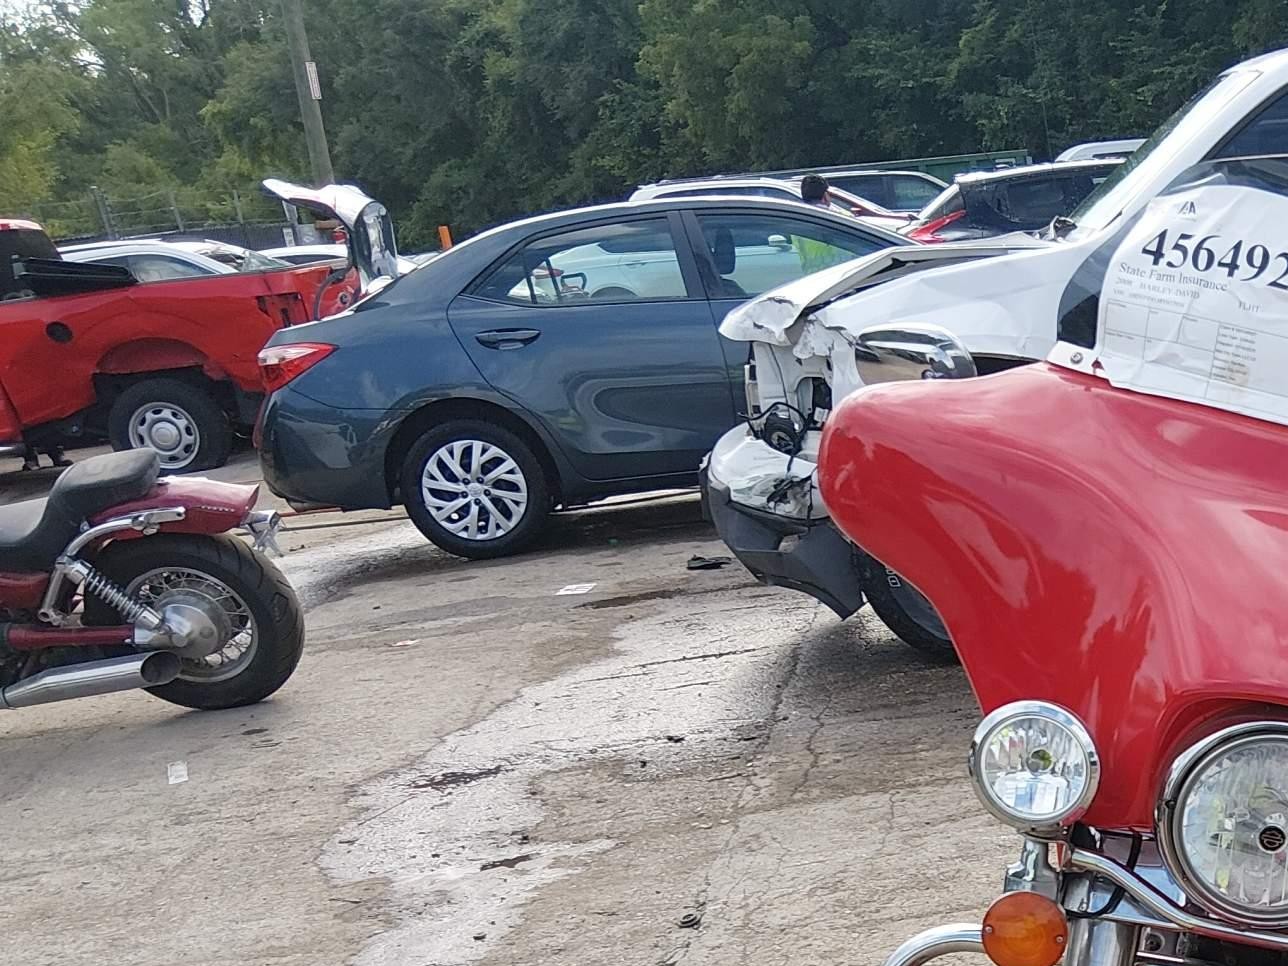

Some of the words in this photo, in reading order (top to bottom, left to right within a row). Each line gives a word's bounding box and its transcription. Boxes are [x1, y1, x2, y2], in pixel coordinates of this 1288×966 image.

[1119, 262, 1147, 278] State
[1149, 269, 1176, 283] Farm
[1178, 271, 1229, 292] Insurance
